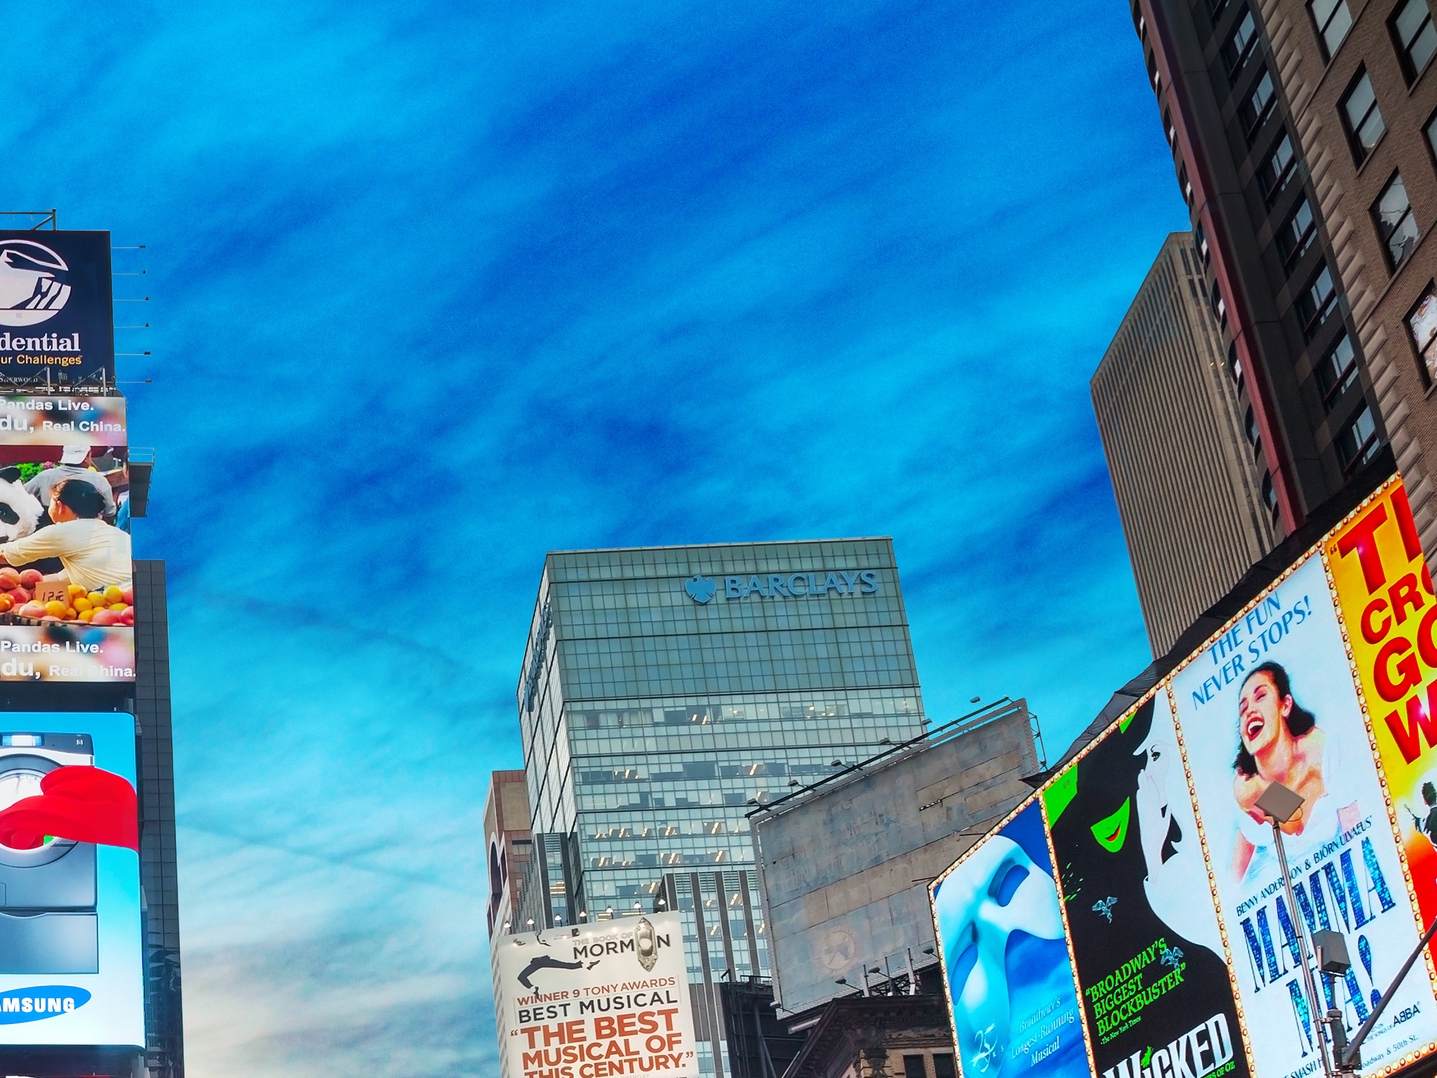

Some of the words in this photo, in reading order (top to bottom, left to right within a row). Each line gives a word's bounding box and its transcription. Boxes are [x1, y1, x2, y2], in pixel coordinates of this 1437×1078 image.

[17, 355, 82, 366] Challenges
[43, 421, 75, 431] Real
[79, 420, 126, 432] China.
[725, 571, 878, 599] BARCLAYS
[1207, 630, 1243, 666] THE
[1248, 591, 1281, 630] FUN
[1, 641, 61, 653] Pandas
[65, 641, 104, 653] Live.
[1191, 658, 1245, 711] NEVER
[1249, 594, 1312, 665] STOPS!
[49, 665, 82, 677] Real
[93, 665, 136, 677] China.
[1239, 836, 1396, 993] MAMMA
[517, 991, 568, 1006] WINNER
[572, 989, 580, 998] 9
[584, 984, 618, 995] TONY
[621, 977, 675, 991] AWARDS
[519, 1003, 570, 1023] BEST
[580, 990, 678, 1014] MUSICAL
[1093, 973, 1143, 1020] BIGGEST
[594, 1008, 679, 1039] BEST
[1018, 995, 1062, 1033] Broadway's
[1011, 1008, 1075, 1060] Longest-Running
[522, 1039, 640, 1070] MUSICAL
[645, 1033, 682, 1053] OF
[1030, 1036, 1060, 1067] Musical
